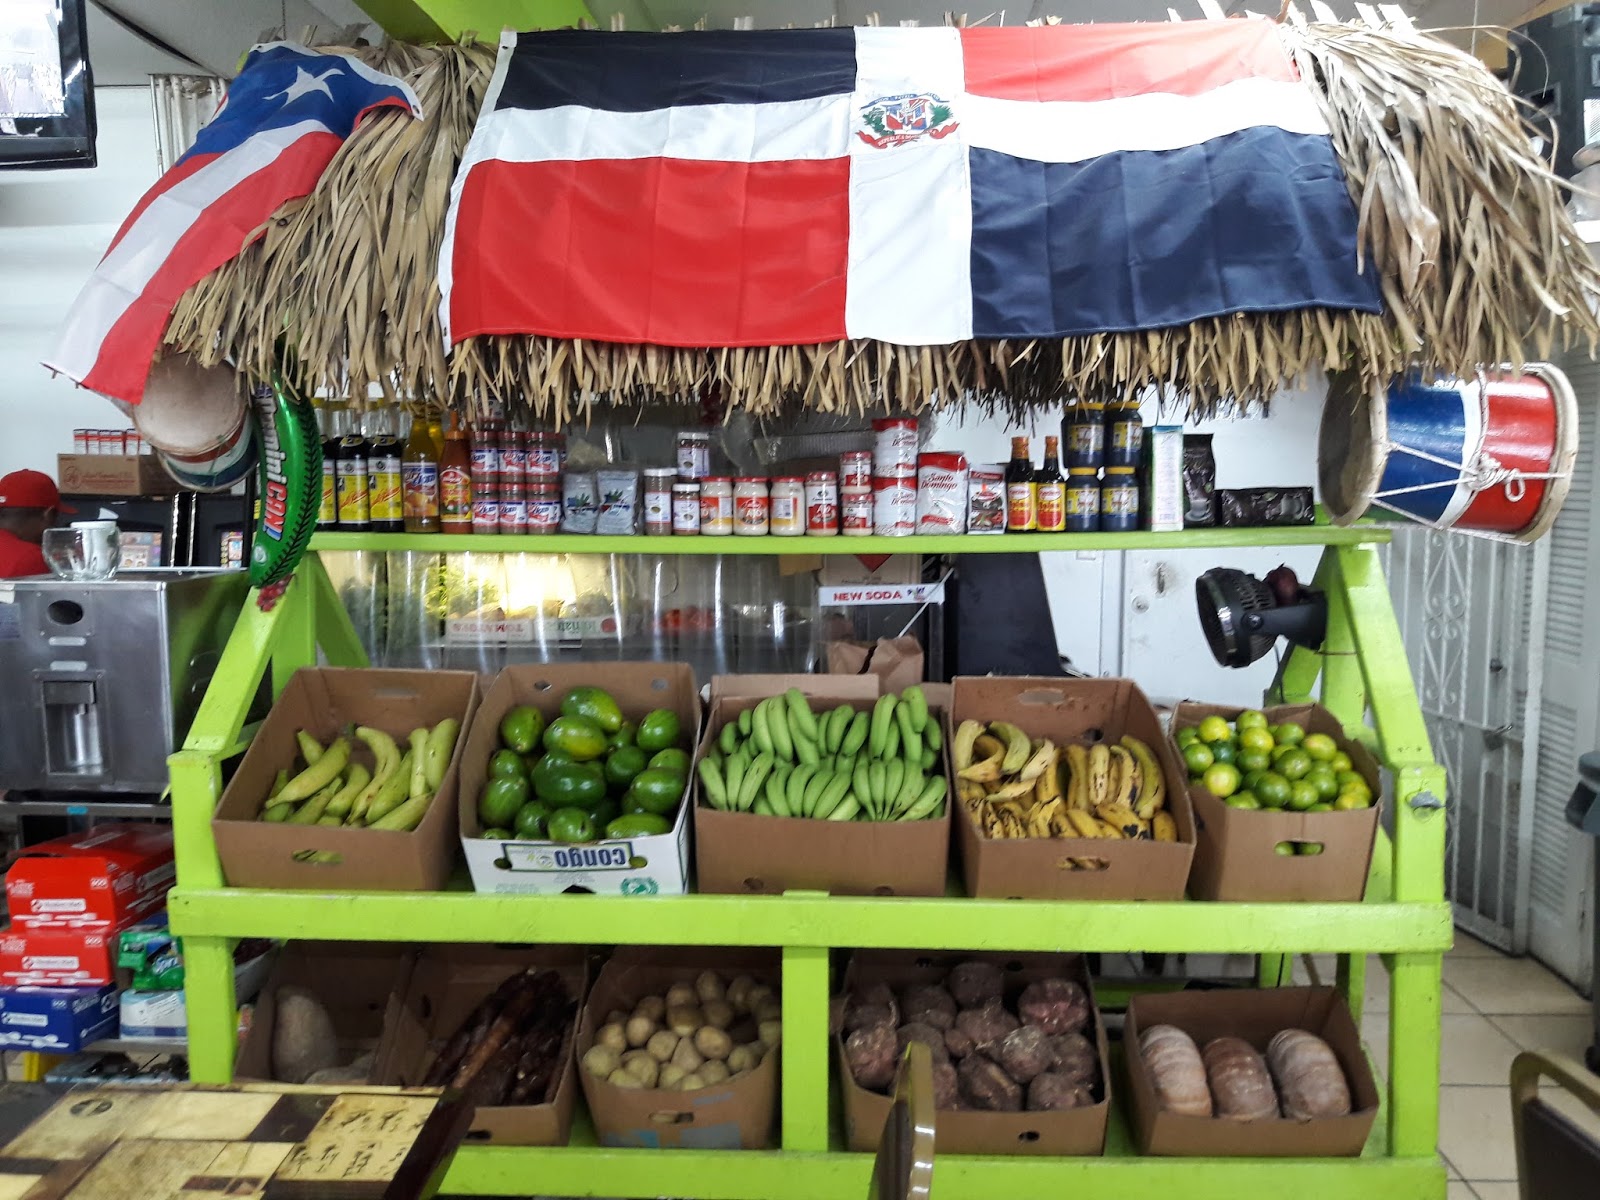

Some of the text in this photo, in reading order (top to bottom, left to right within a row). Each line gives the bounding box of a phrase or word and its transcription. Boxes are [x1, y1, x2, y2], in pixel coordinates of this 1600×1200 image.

[920, 481, 958, 493] Domingo
[833, 591, 863, 602] NEW
[864, 590, 903, 601] SODA
[553, 848, 625, 869] congo
